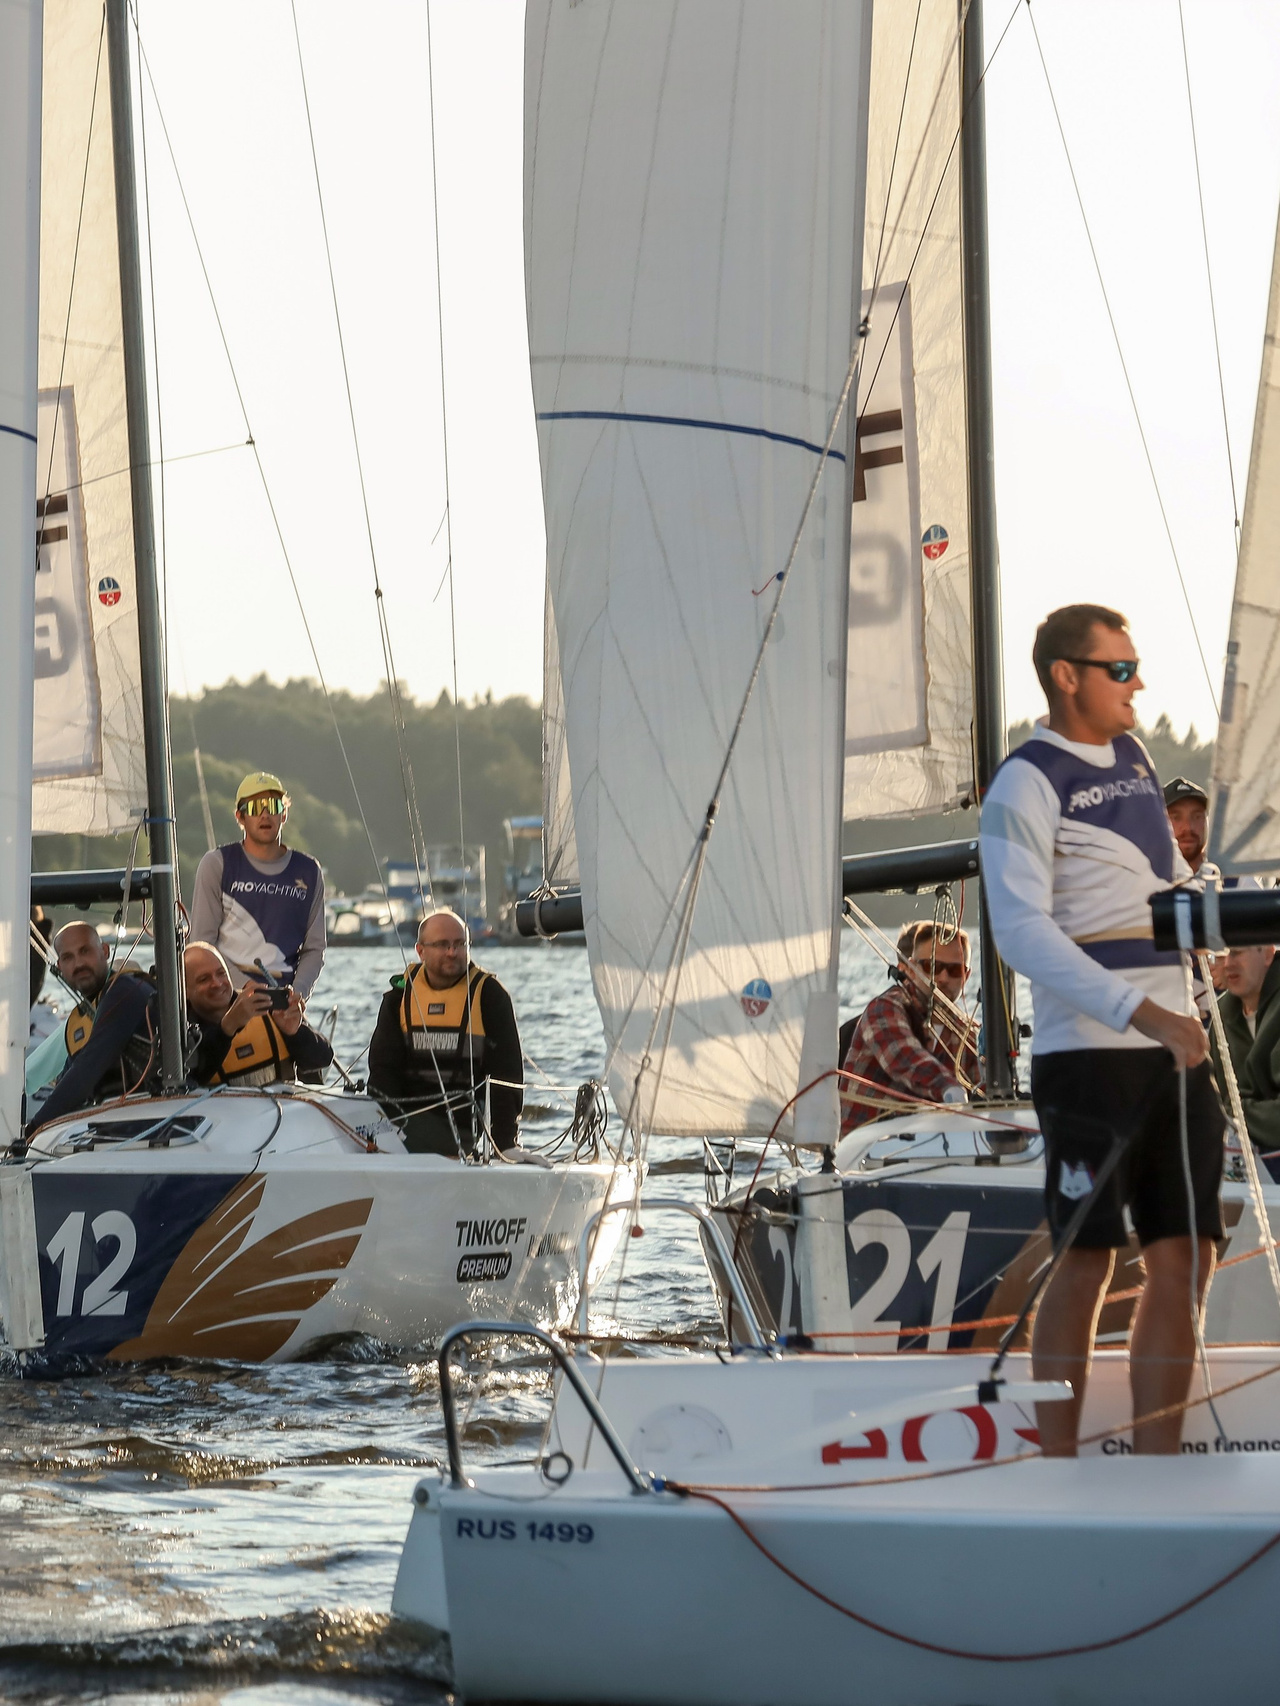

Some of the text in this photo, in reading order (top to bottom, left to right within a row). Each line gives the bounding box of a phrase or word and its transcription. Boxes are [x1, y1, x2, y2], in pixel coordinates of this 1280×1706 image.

[1068, 778, 1158, 813] PROYACHTIN
[230, 880, 307, 901] PROYACHTING
[455, 1217, 527, 1248] TINKOFF
[45, 1209, 137, 1317] 12
[459, 1256, 511, 1278] PREMIUM
[847, 1208, 971, 1353] 21
[1102, 1438, 1208, 1455] Chng
[457, 1518, 595, 1544] RUS 1499
